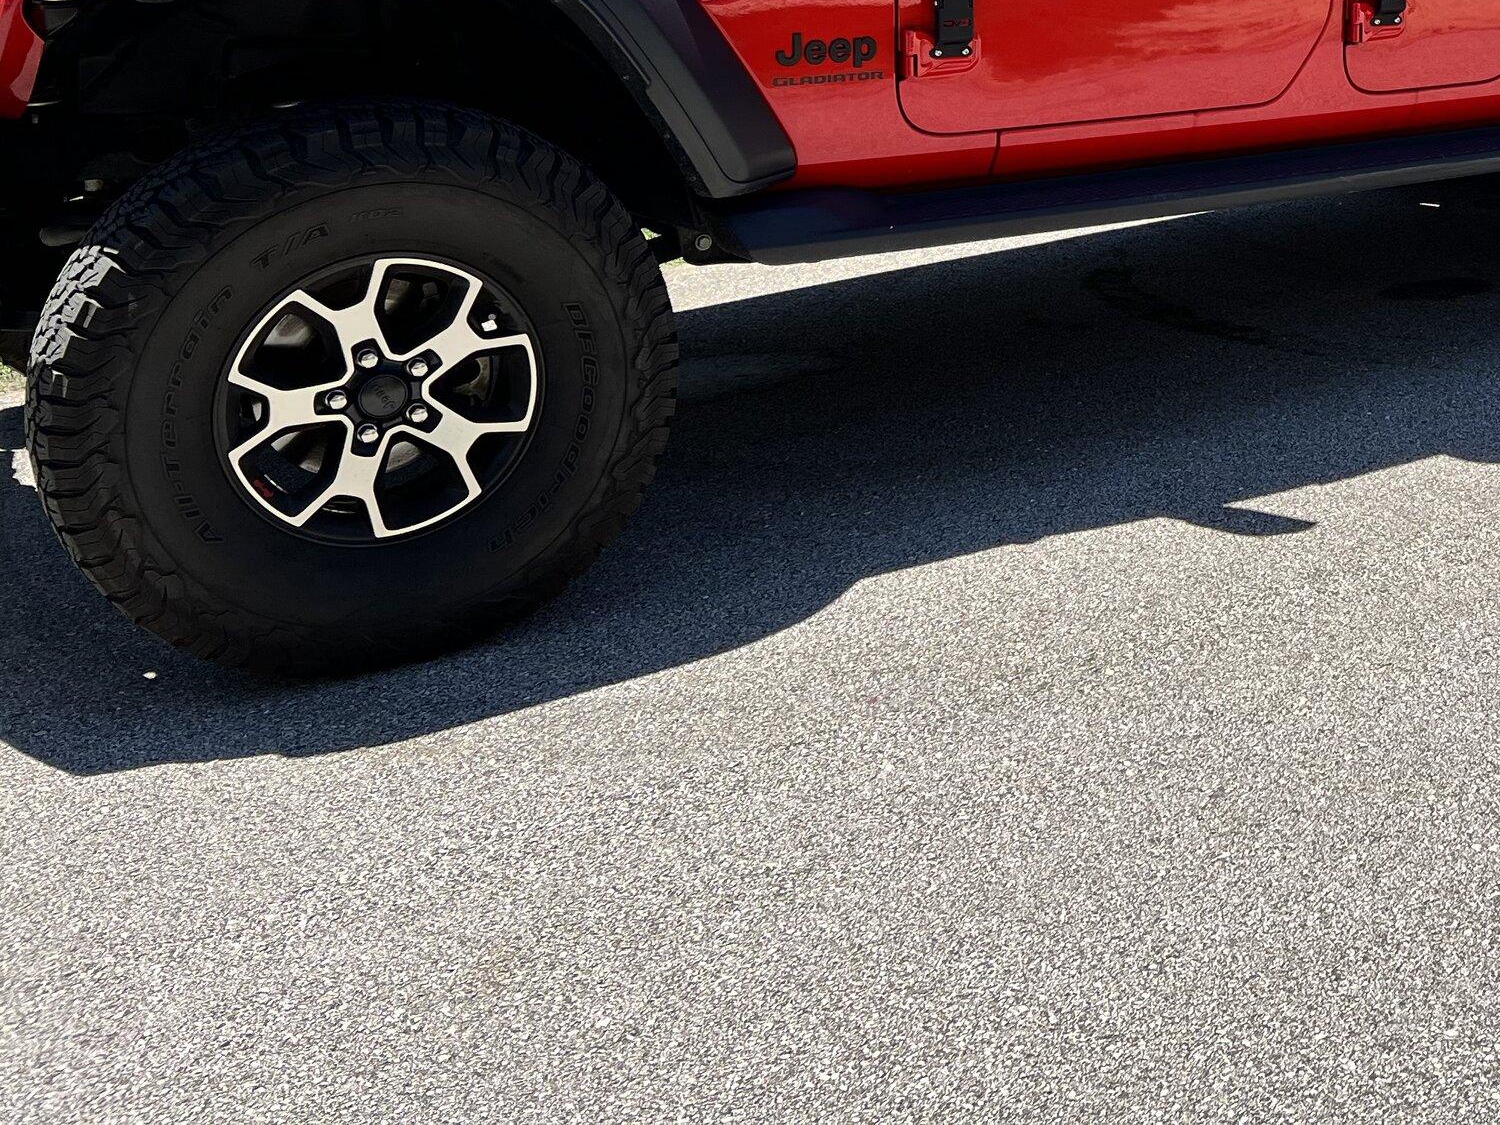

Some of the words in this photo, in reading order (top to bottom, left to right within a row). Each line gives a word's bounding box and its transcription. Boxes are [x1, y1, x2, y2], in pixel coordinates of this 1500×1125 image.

[771, 70, 884, 87] GLADIATOR
[775, 32, 877, 68] Jeep
[159, 283, 234, 546] All-Terrain
[249, 221, 330, 270] T/A
[487, 301, 600, 556] BFGoodrich
